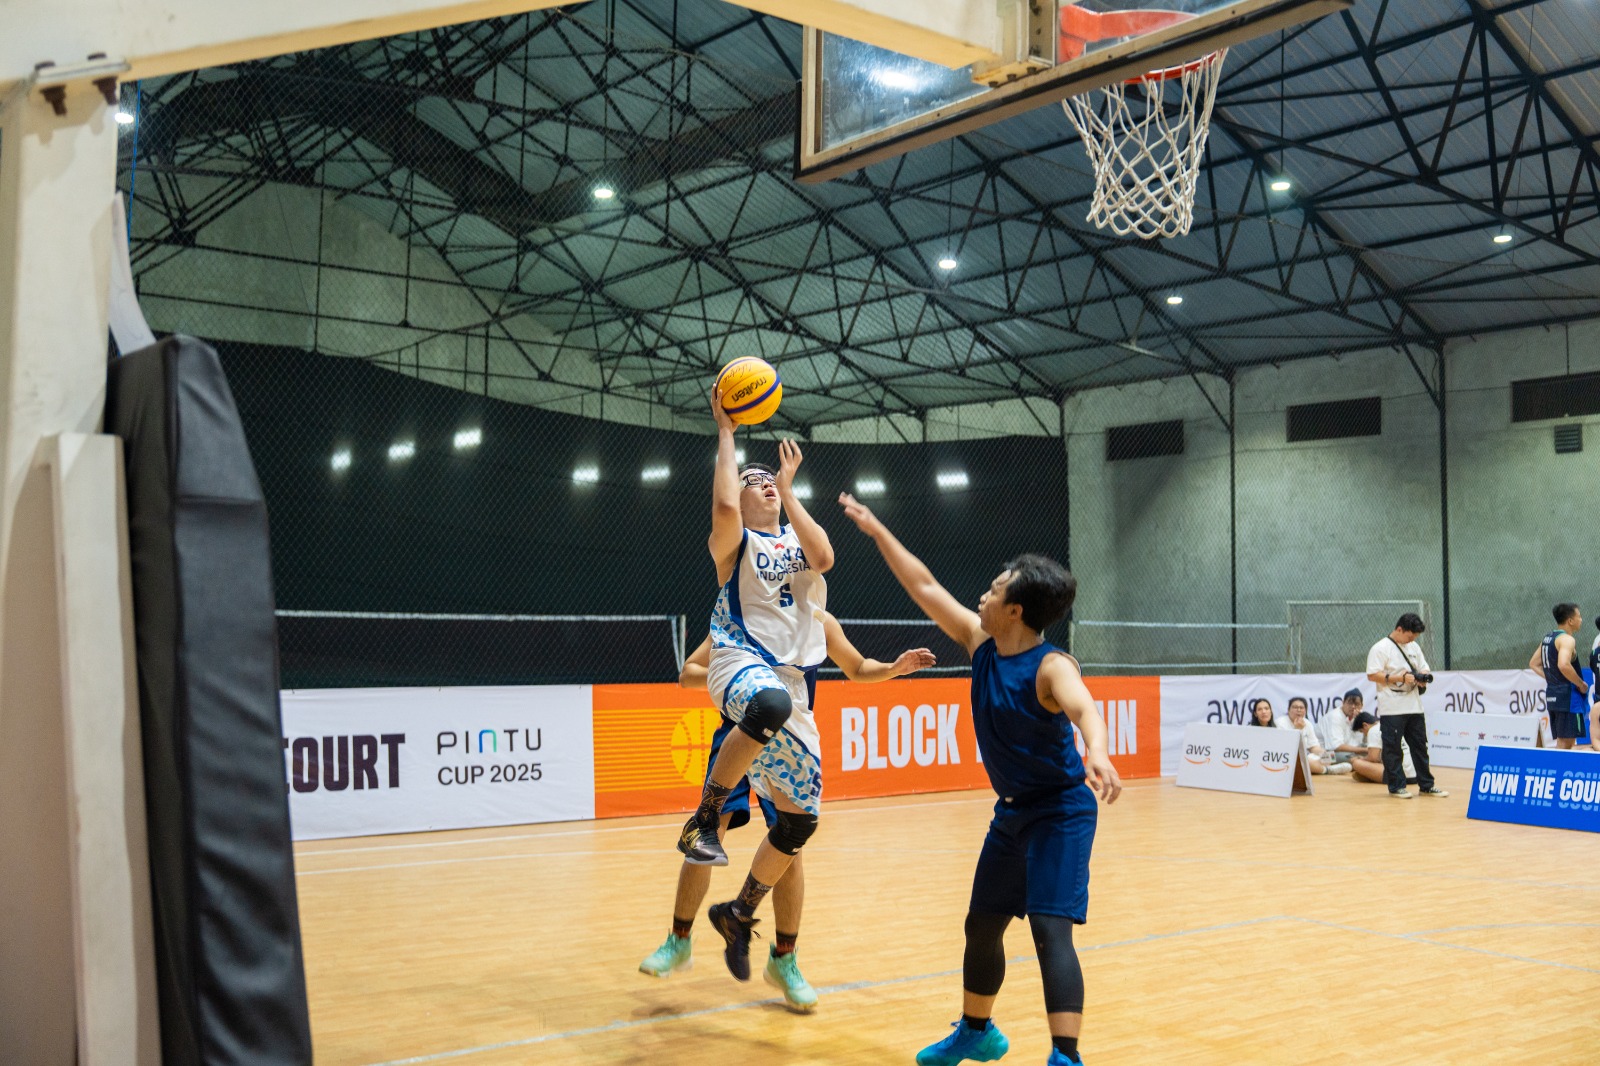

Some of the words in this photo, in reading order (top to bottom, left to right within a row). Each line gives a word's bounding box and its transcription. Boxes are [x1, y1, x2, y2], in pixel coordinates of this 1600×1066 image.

[731, 376, 767, 403] molten
[756, 547, 807, 570] DANA
[757, 562, 811, 581] INDONESIA
[779, 583, 794, 608] 5
[1445, 691, 1486, 714] aws
[1509, 688, 1547, 714] aws
[437, 728, 541, 755] PINTU
[841, 703, 961, 772] BLOCK
[1185, 744, 1212, 757] aws
[1223, 747, 1250, 761] aws
[1262, 750, 1290, 764] aws
[437, 765, 485, 786] CUP
[490, 763, 543, 783] 2025
[1478, 771, 1520, 796] OWN
[1523, 775, 1556, 800] THE
